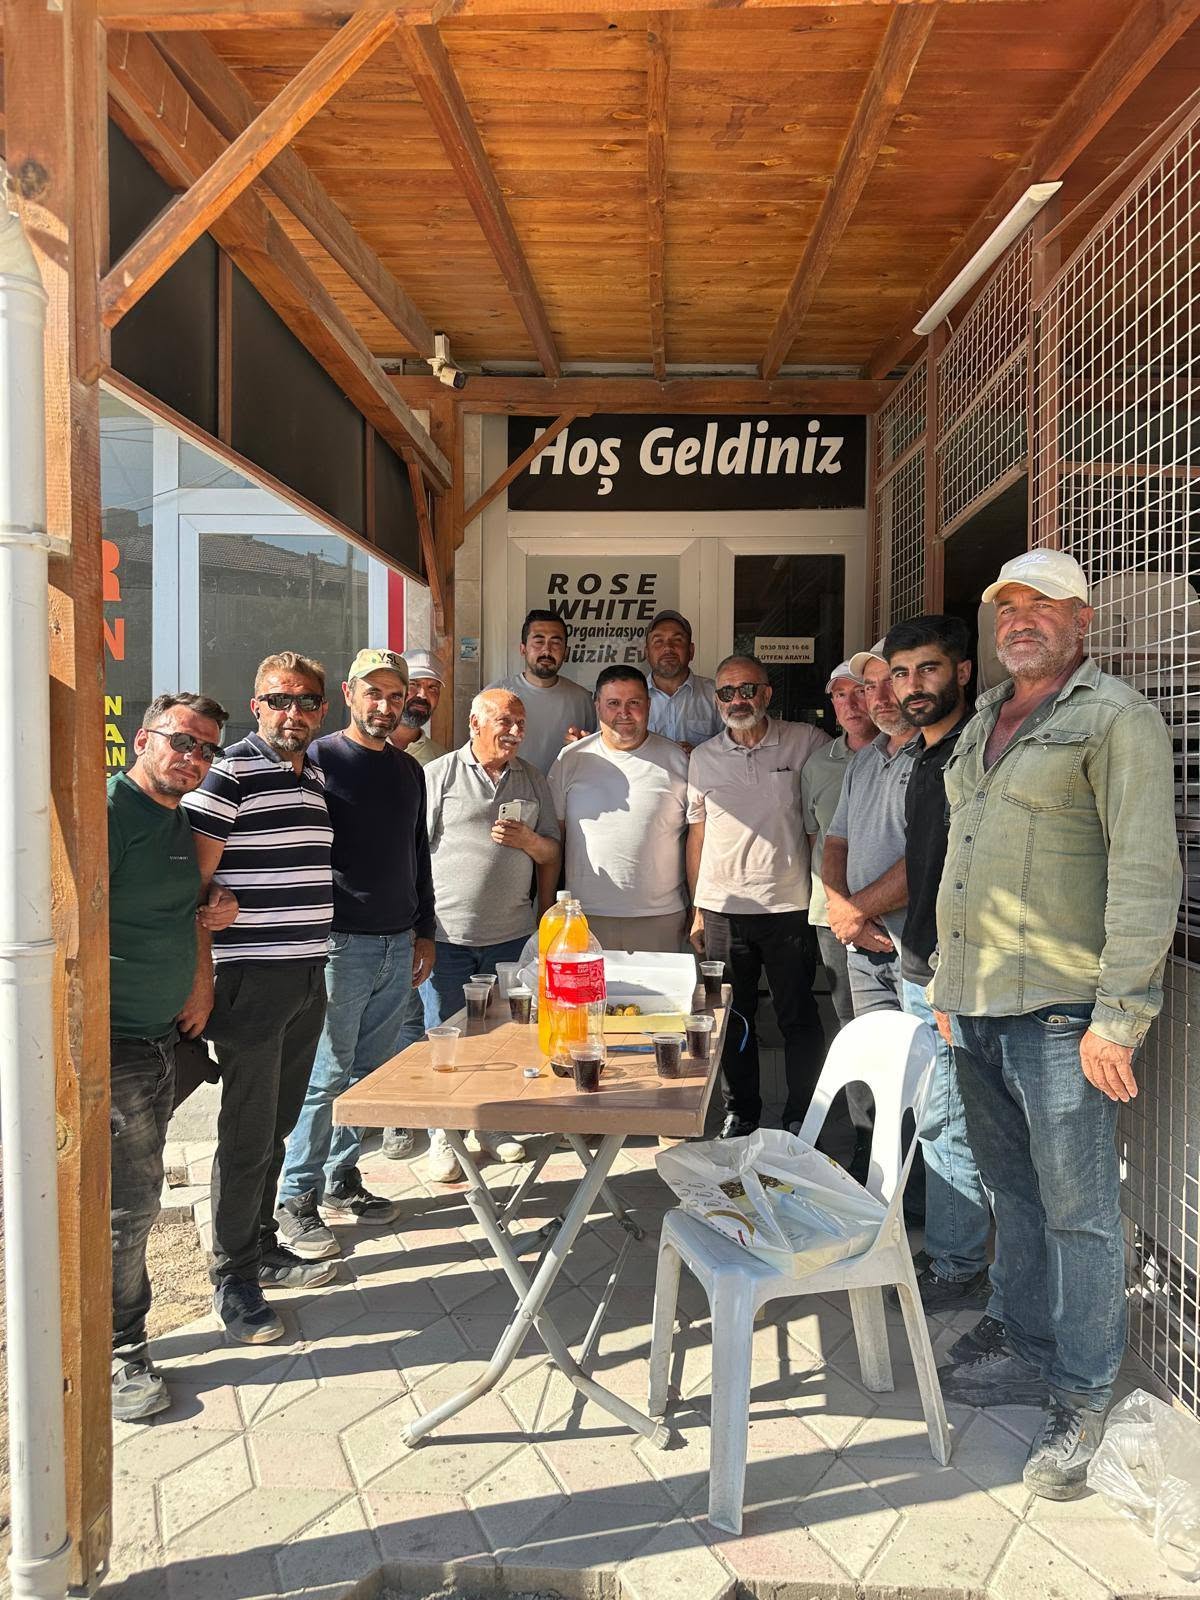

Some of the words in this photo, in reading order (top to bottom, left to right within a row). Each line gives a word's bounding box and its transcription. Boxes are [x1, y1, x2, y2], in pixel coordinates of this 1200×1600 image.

[529, 427, 622, 496] Hoş
[639, 420, 844, 475] Geldiniz
[547, 573, 657, 595] ROSE
[549, 599, 657, 620] WHITE
[564, 644, 618, 663] üzik
